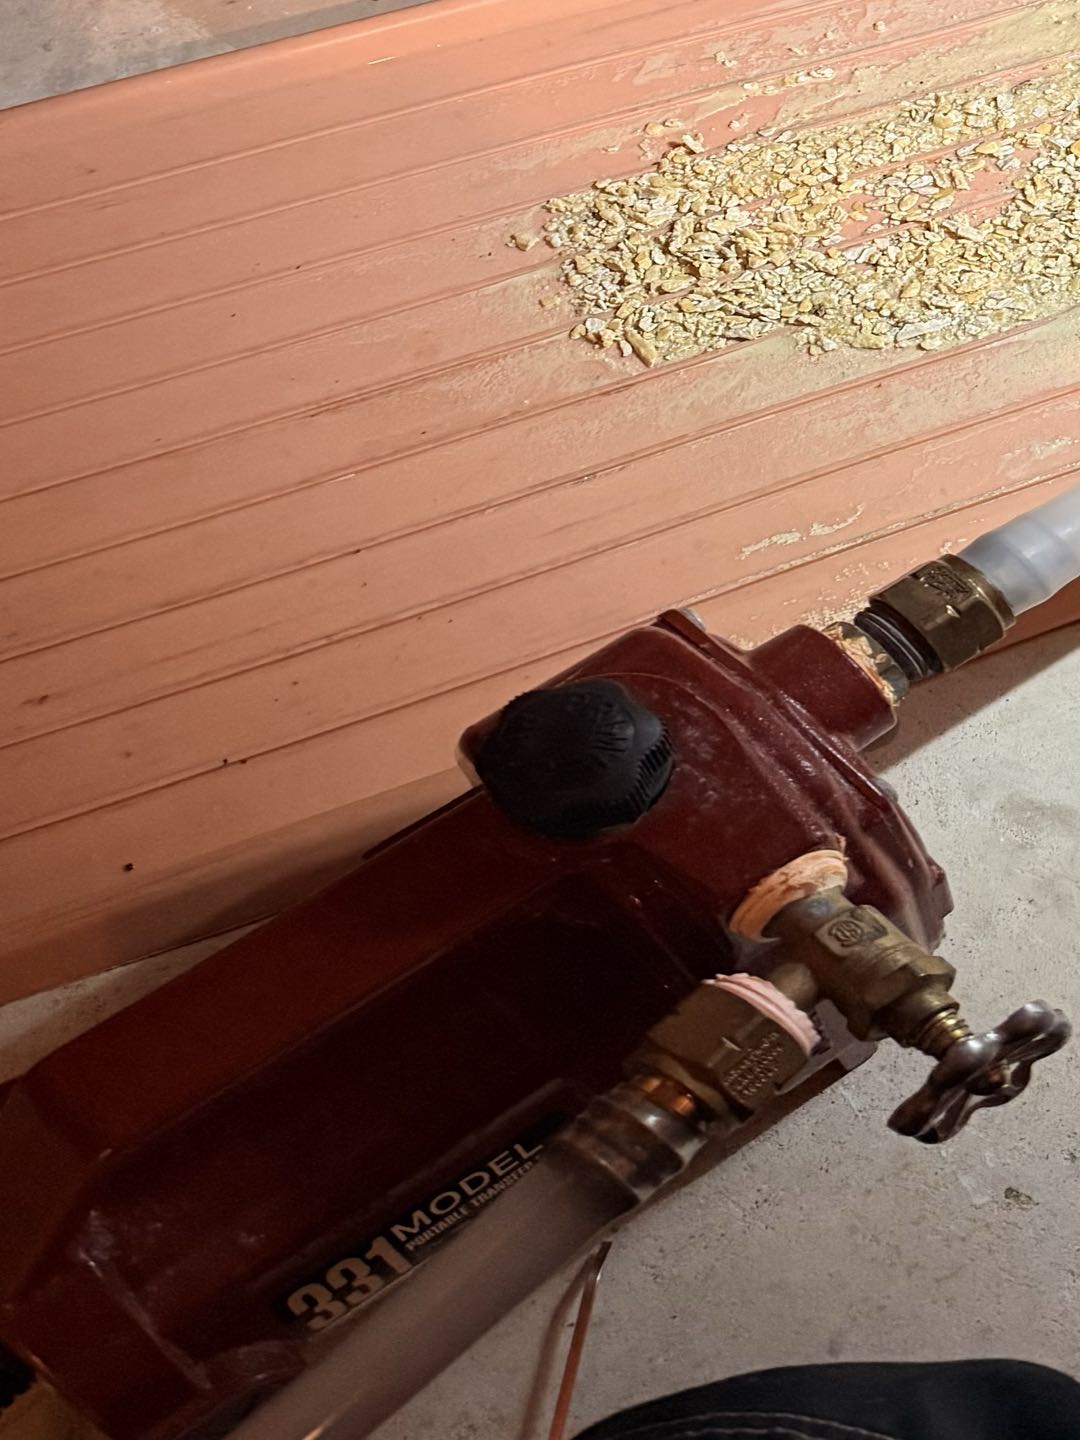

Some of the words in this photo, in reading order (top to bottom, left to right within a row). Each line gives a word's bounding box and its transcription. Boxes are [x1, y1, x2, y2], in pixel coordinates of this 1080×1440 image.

[287, 1236, 414, 1331] 331
[390, 1143, 544, 1242] MODEL
[404, 1205, 471, 1251] PORTABLE
